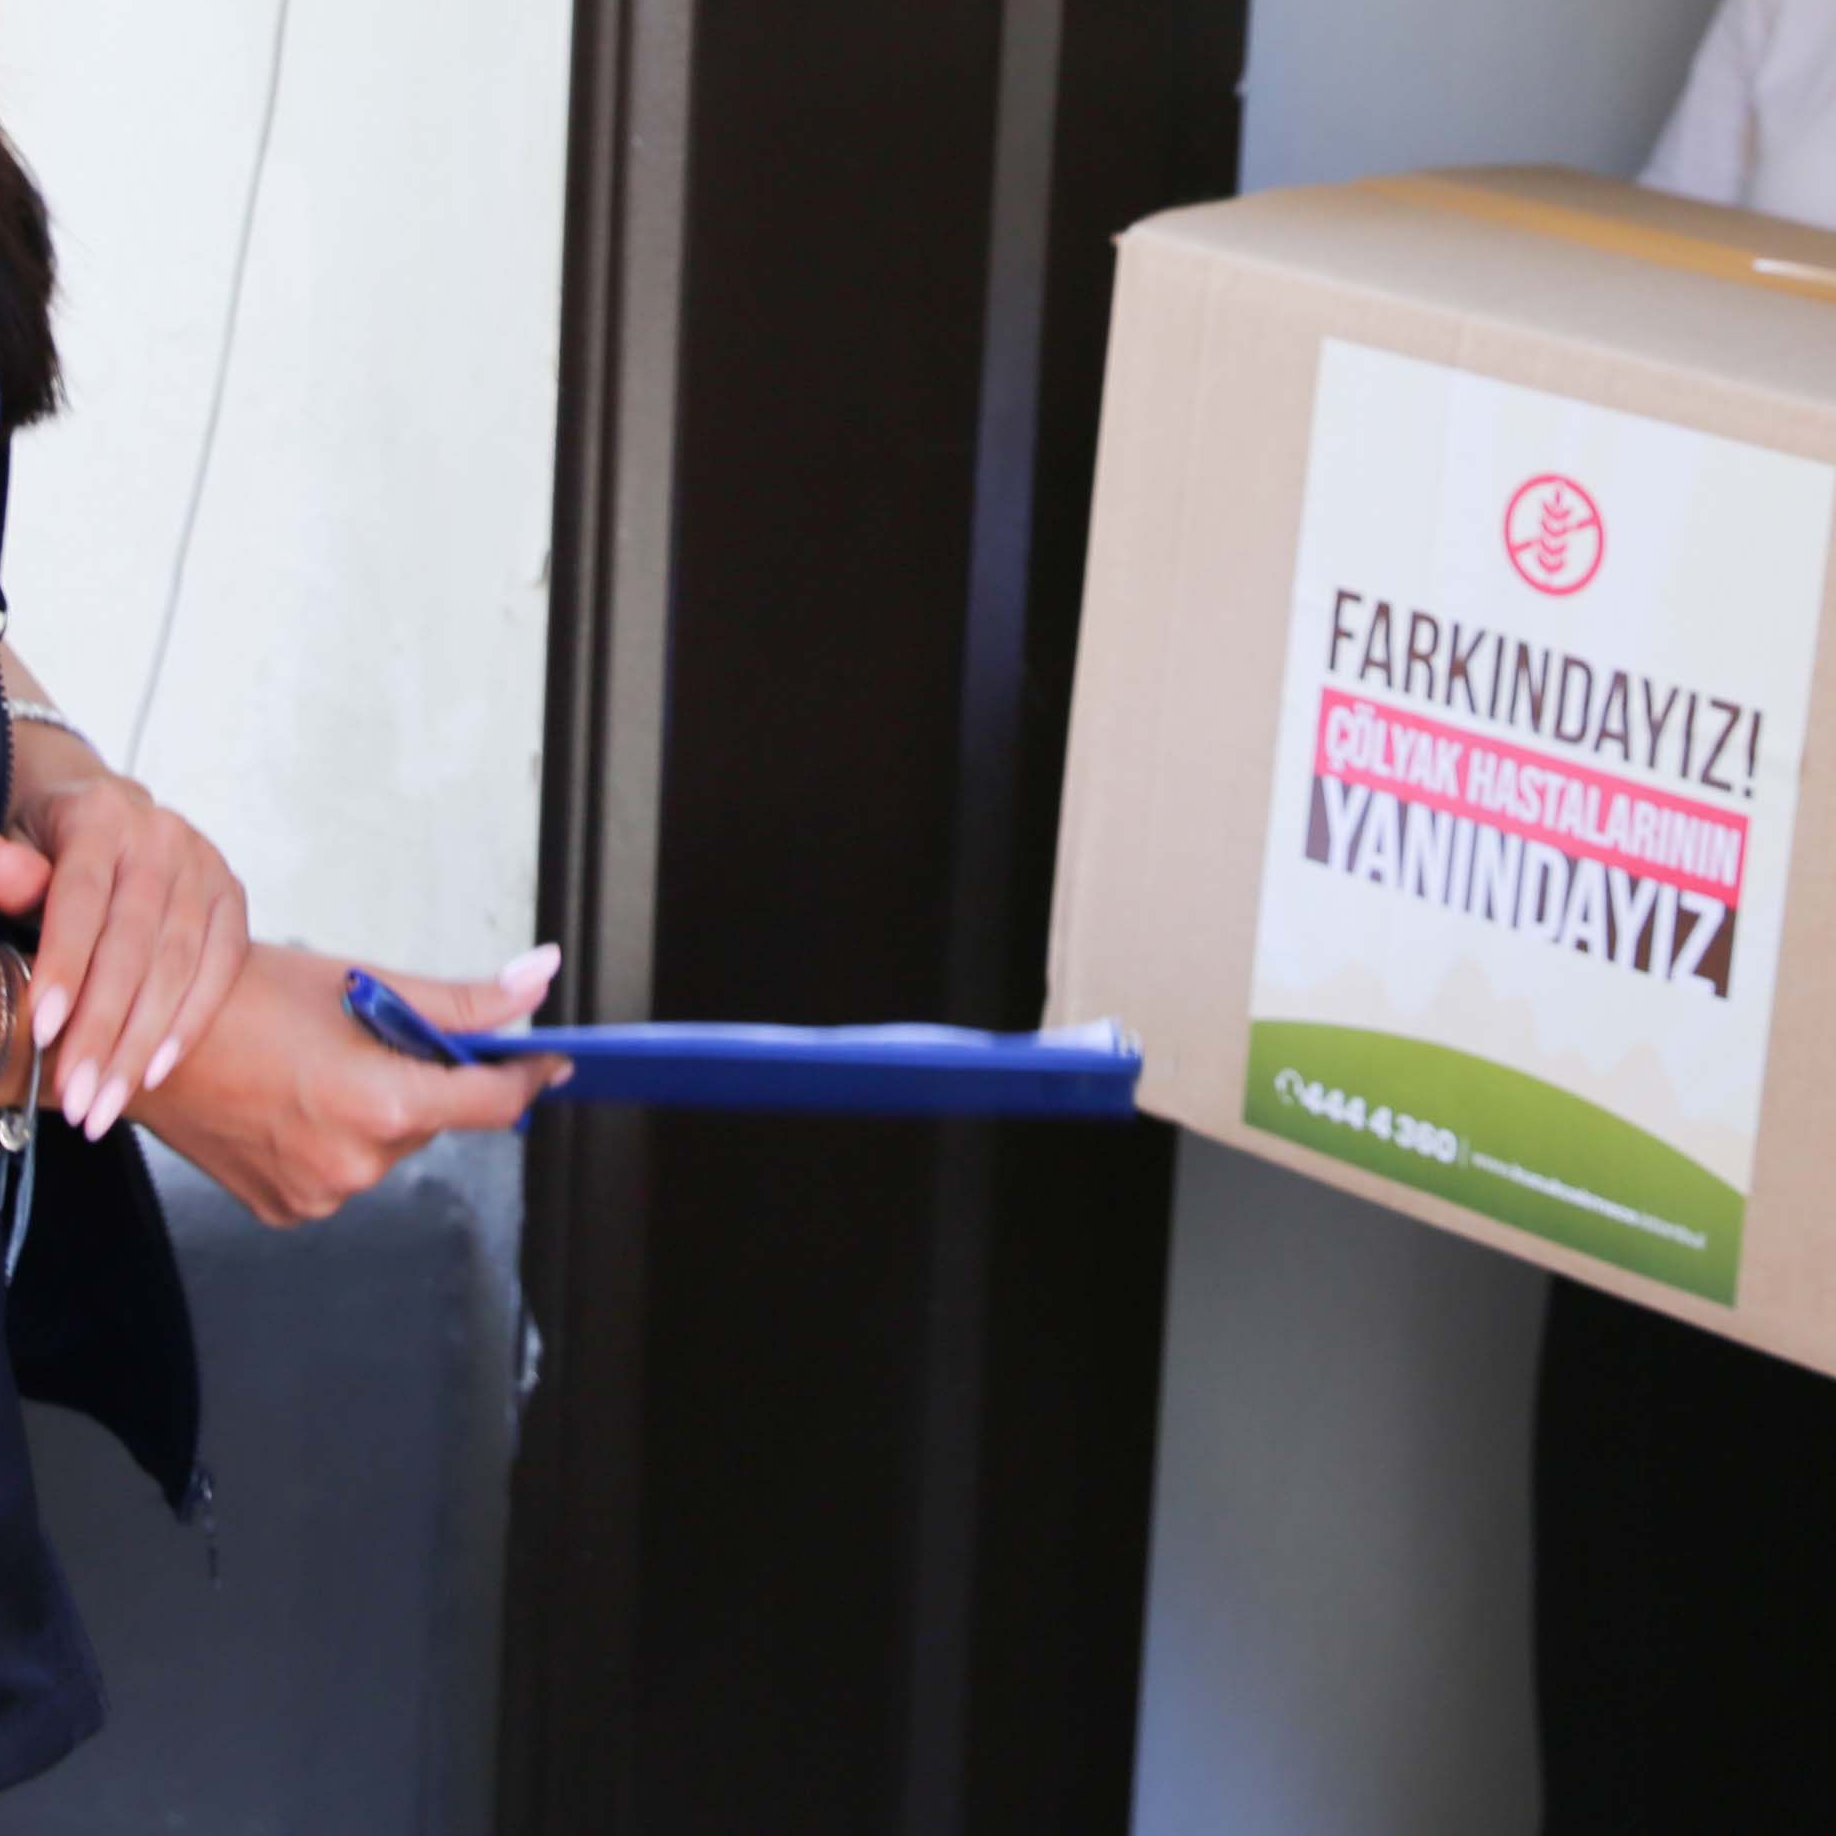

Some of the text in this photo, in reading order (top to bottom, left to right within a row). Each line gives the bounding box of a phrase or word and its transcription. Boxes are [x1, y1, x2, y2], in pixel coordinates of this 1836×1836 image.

[1325, 587, 1764, 800] FARKINDAYIZ!
[1320, 774, 1726, 996] YANINDAYIZ
[1465, 747, 1742, 890] HASTALARININ
